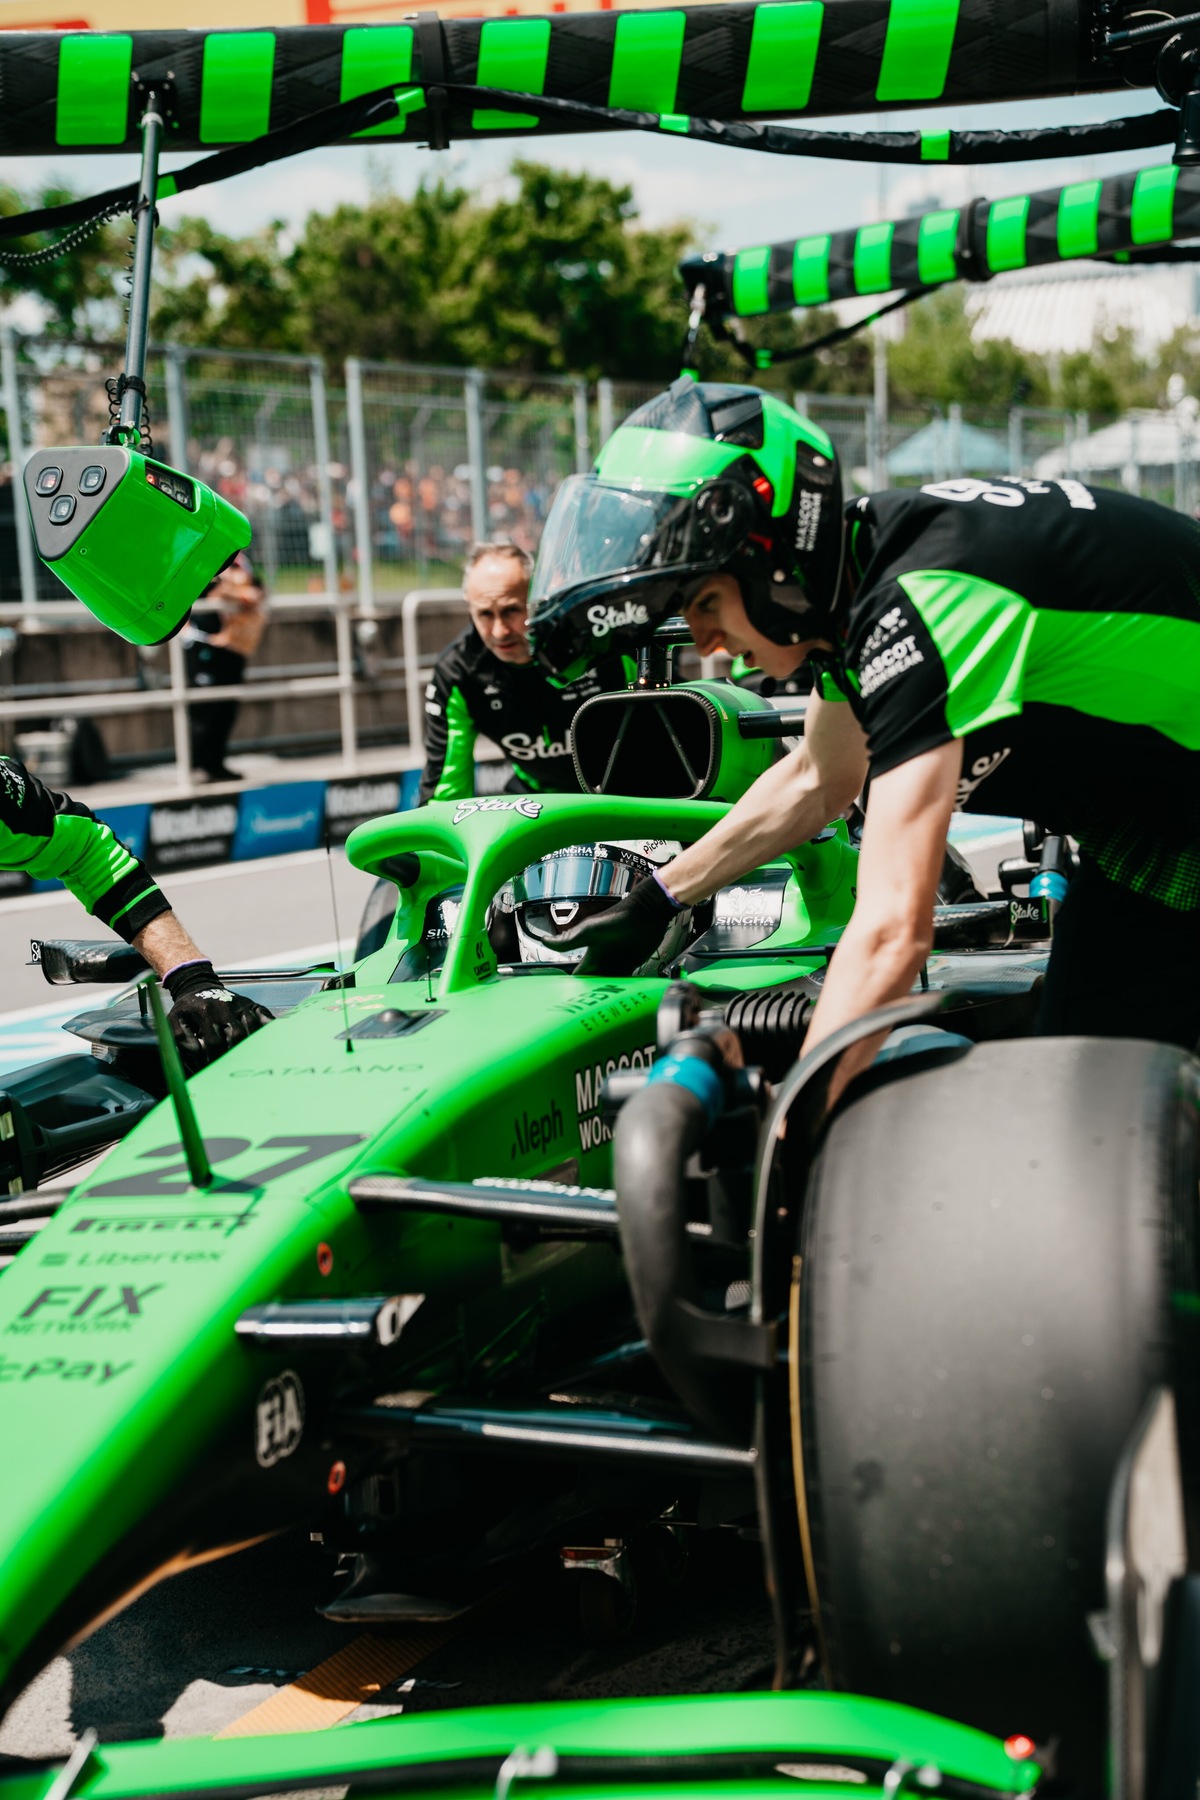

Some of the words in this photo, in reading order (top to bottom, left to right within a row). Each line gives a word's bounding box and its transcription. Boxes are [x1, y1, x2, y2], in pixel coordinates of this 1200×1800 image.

[587, 601, 649, 638] Stake
[453, 798, 543, 825] Stake
[620, 858, 653, 874] EYEWEA
[717, 916, 774, 925] SINGHA
[1010, 901, 1039, 925] Stake
[229, 1063, 425, 1079] CATALANO
[511, 1098, 564, 1161] Aleph
[83, 1133, 370, 1197] 27
[69, 1213, 258, 1234] PIRELLI
[77, 1250, 224, 1267] Libertex
[19, 1283, 165, 1320] FIX
[256, 1386, 301, 1455] FIA
